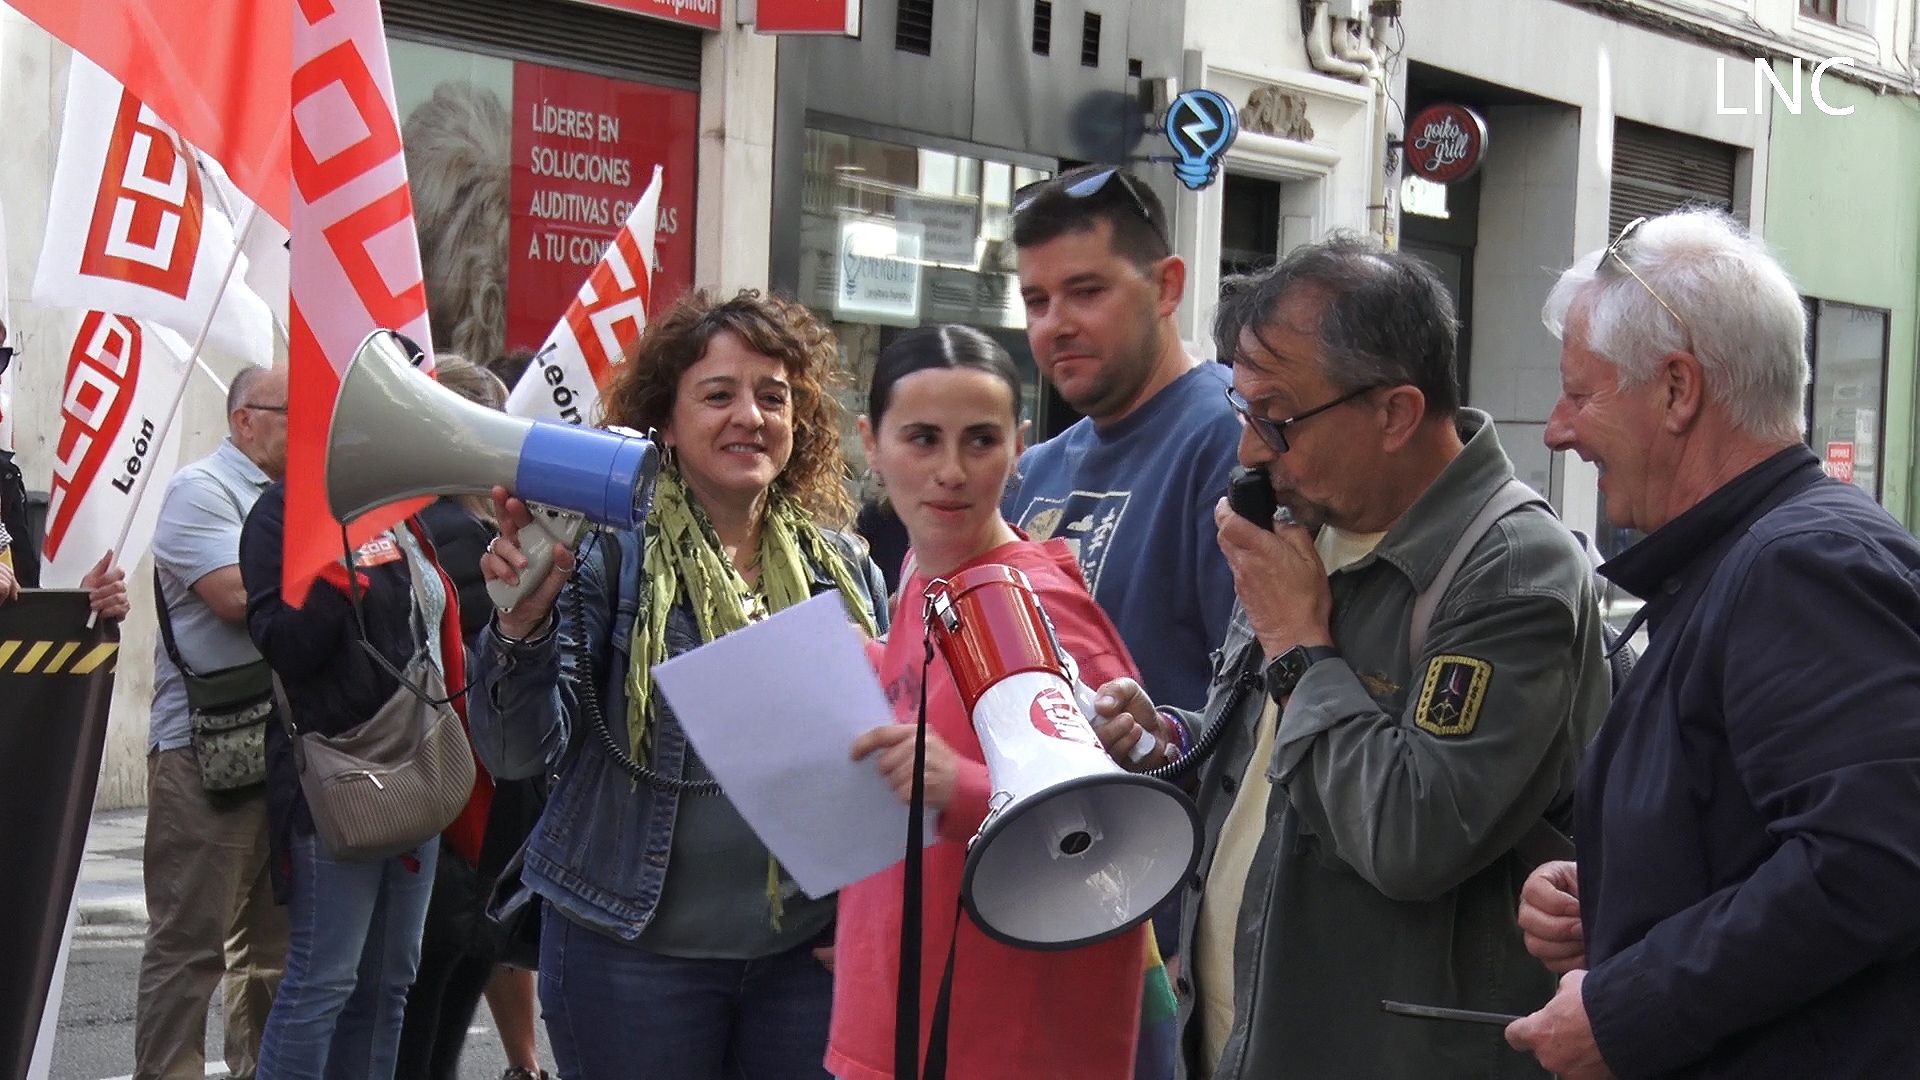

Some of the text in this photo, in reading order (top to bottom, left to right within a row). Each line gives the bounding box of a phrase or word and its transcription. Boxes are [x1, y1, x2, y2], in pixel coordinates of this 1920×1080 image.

[532, 98, 620, 144] LÍDERES EN
[1415, 115, 1460, 149] goiko
[531, 146, 631, 188] SOLUCIONES
[1425, 133, 1469, 171] grill
[529, 190, 609, 226] AUDITIVAS
[528, 231, 541, 259] A
[545, 234, 565, 263] TU
[536, 342, 583, 426] León
[112, 416, 155, 495] León
